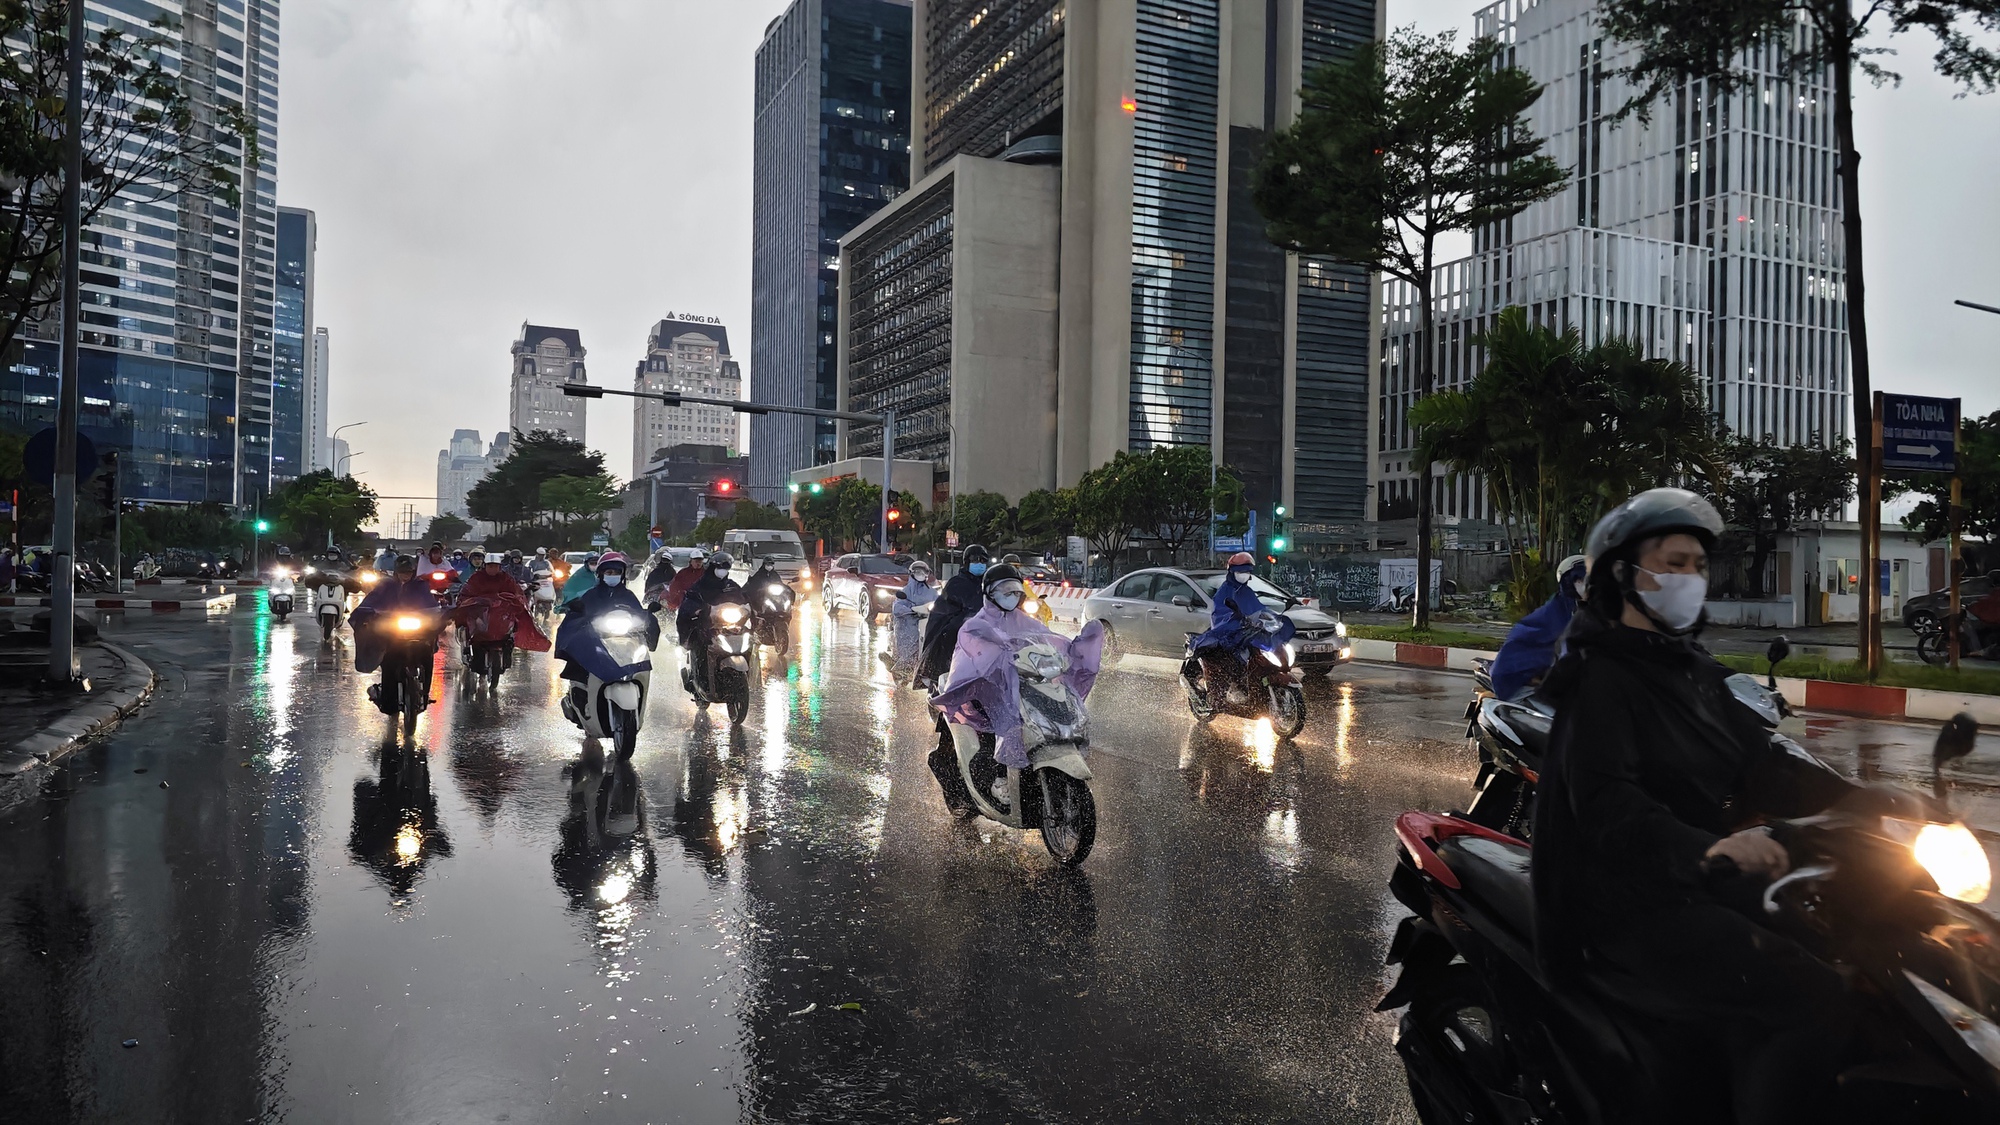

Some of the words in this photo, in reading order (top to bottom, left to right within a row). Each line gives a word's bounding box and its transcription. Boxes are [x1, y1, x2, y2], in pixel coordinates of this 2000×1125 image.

[679, 312, 705, 323] SÔNG
[1896, 399, 1919, 420] TÒA
[1921, 402, 1945, 422] NHÀ
